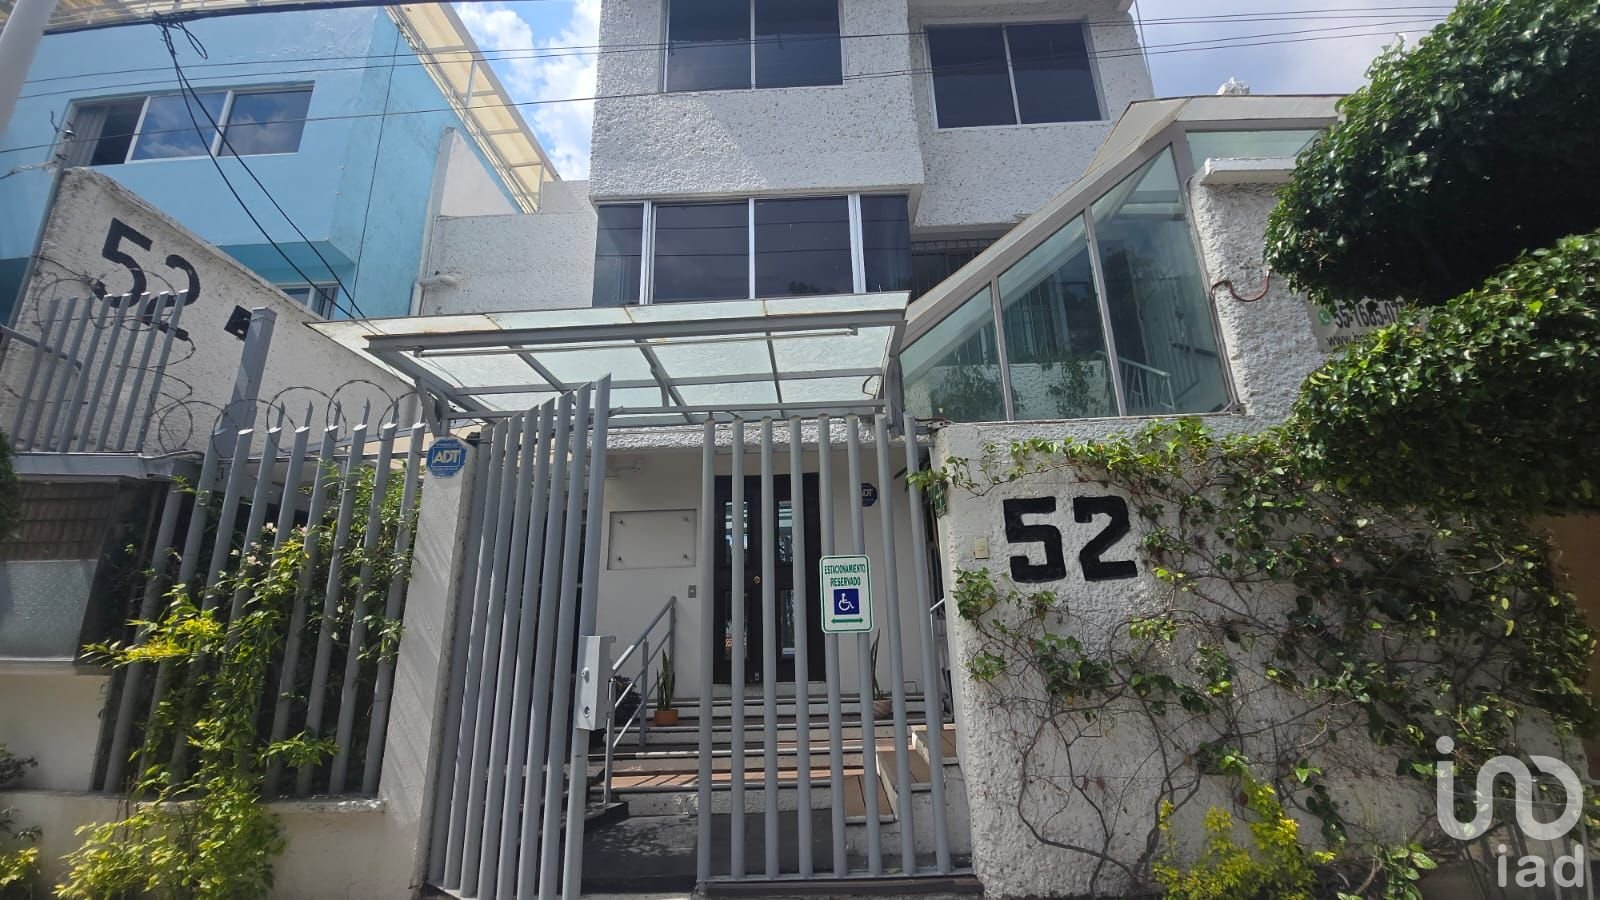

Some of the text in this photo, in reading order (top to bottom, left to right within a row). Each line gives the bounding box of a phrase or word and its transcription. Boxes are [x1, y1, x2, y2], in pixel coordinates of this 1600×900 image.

[91, 217, 200, 342] 52
[432, 450, 461, 463] ADT
[1003, 496, 1138, 583] 52
[824, 563, 866, 575] ESTACIONAMIENTO
[830, 576, 861, 587] RESERVADO
